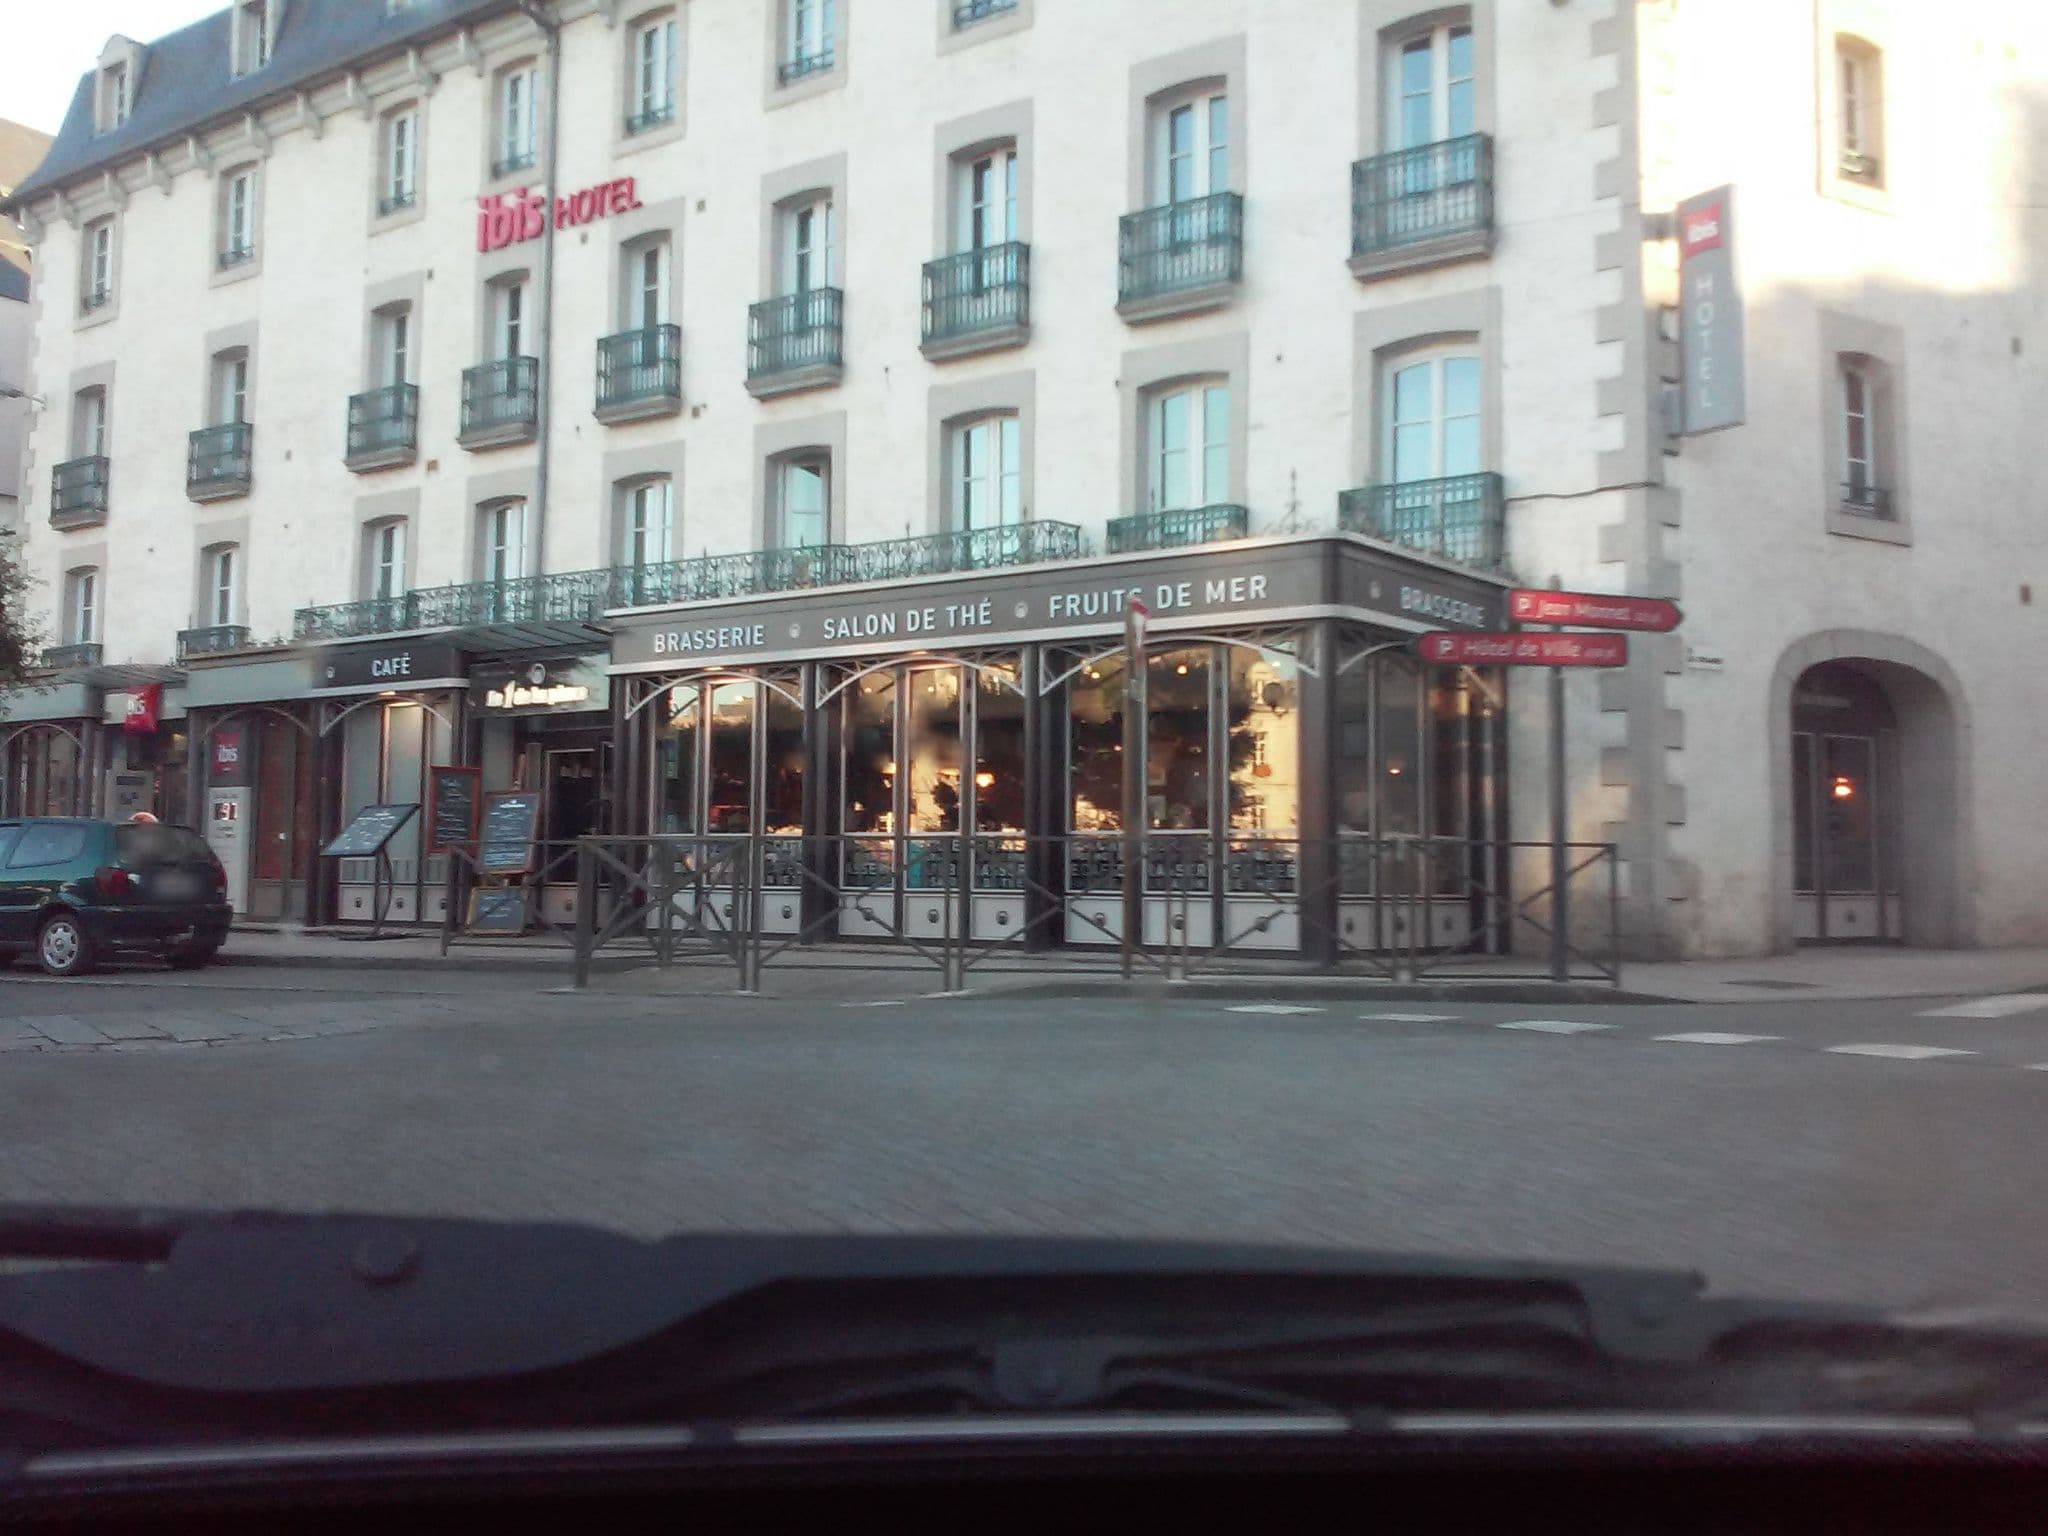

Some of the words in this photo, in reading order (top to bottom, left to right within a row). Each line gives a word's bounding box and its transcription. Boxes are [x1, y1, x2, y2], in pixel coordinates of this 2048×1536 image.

[477, 185, 545, 253] ibis
[553, 176, 643, 230] HOTEL
[1695, 273, 1715, 409] HOTEL
[654, 624, 765, 653] BRASSERIE
[823, 612, 897, 640] SALON
[906, 607, 936, 632] DE
[945, 597, 993, 628] THÉ
[1156, 581, 1193, 610] DE
[1205, 574, 1269, 605] MER
[1400, 586, 1485, 629] BRASSERIE
[371, 652, 412, 678] CAFÉ
[1516, 639, 1539, 658] de
[1542, 638, 1582, 658] Ville
